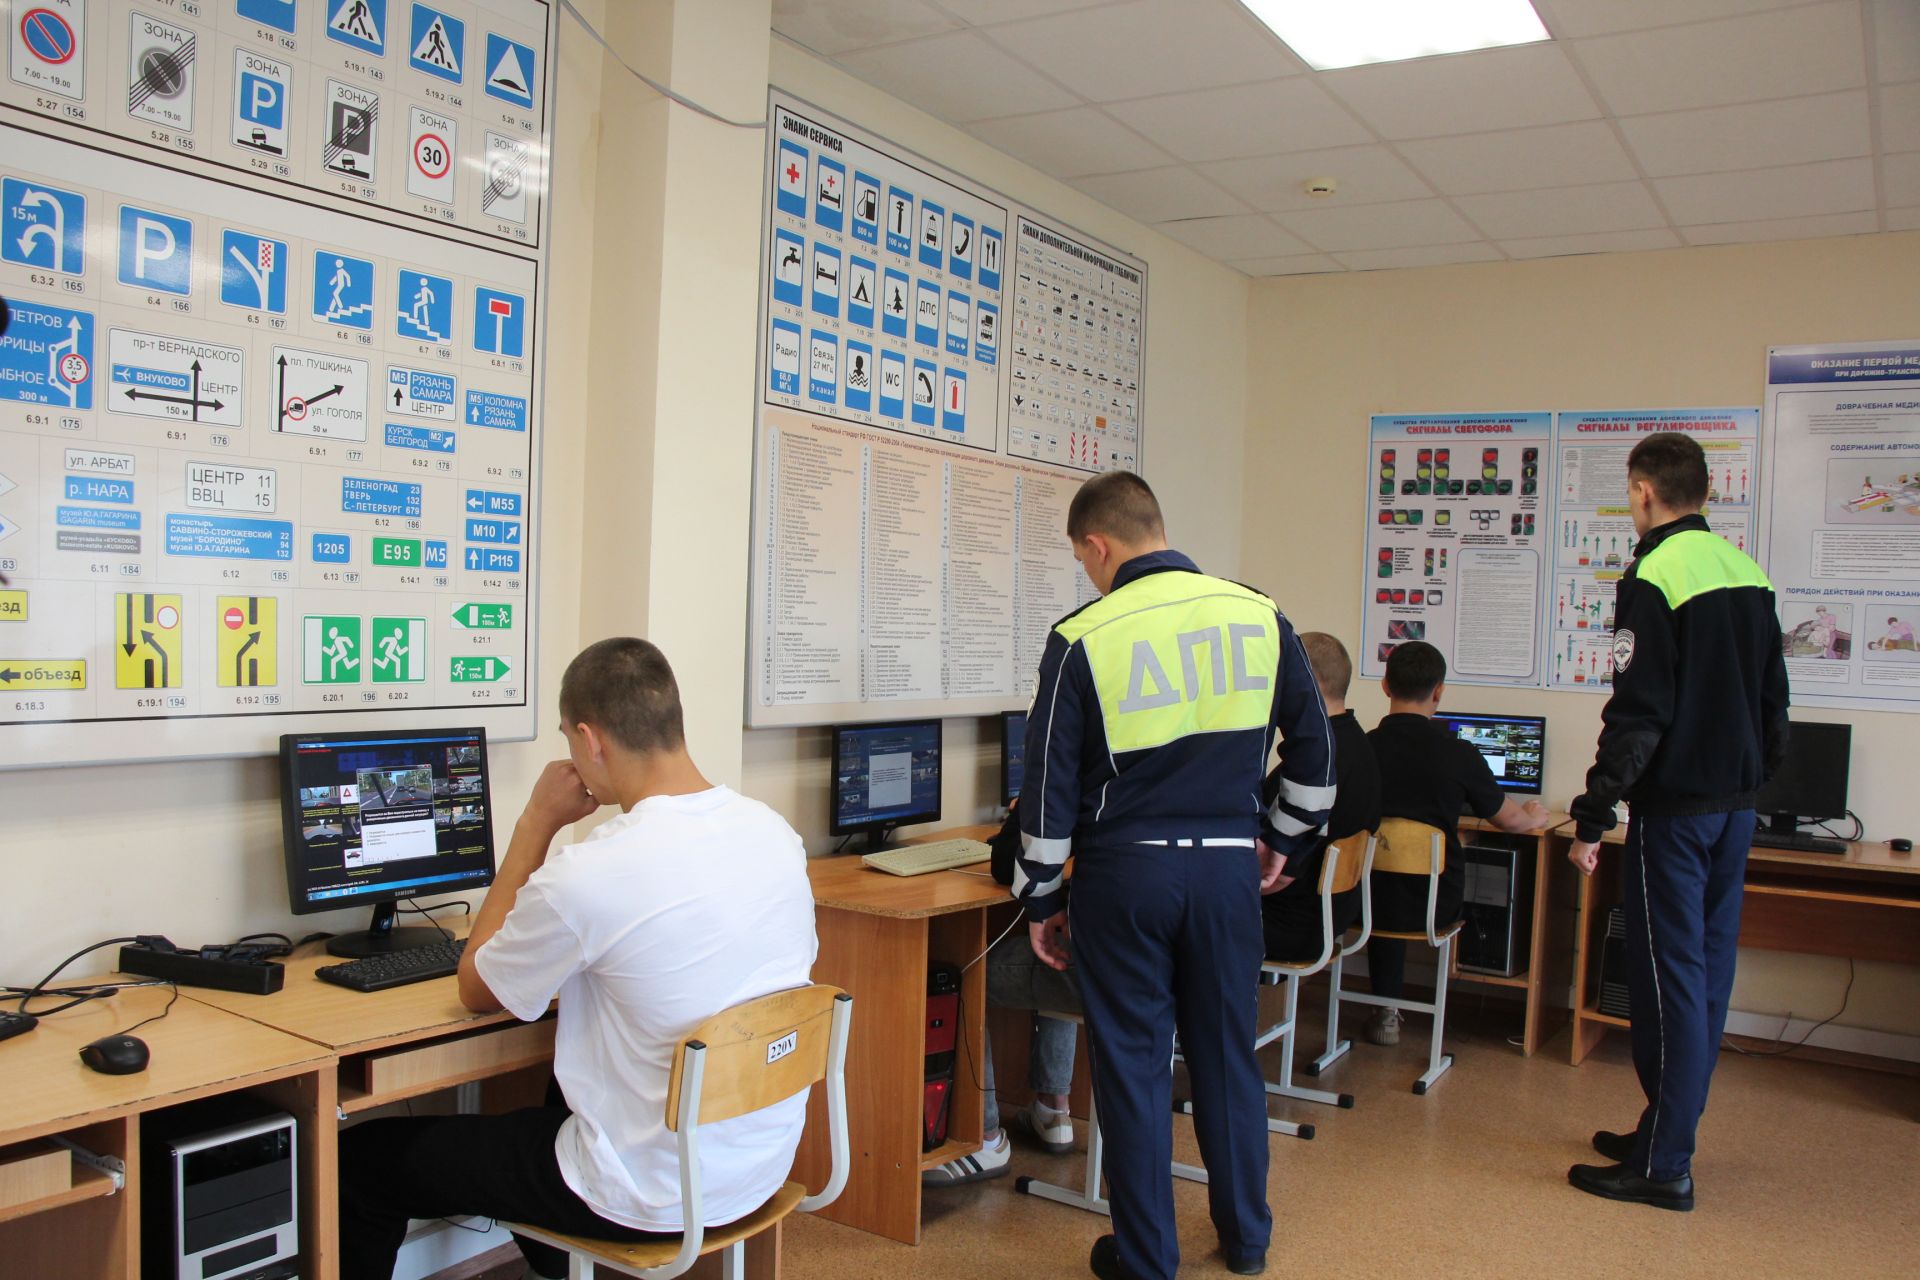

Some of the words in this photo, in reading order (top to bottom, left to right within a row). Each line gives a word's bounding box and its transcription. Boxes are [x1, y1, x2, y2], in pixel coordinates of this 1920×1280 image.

[183, 3, 197, 15] 141
[144, 21, 185, 46] ЗОНА
[257, 30, 274, 42] 5.18
[281, 39, 295, 49] 142
[246, 56, 281, 78] ЗОНА
[344, 61, 365, 73] 5.19.1
[24, 66, 42, 80] 7.00
[50, 74, 71, 88] 19.00
[370, 70, 383, 79] 143
[337, 87, 368, 106] ЗОНА
[449, 96, 462, 107] 144
[36, 97, 58, 111] 5.27
[66, 105, 84, 119] 154
[141, 103, 156, 113] 7.00
[163, 110, 182, 121] 19.00
[419, 114, 448, 131] ЗОНА
[783, 115, 809, 138] ЗНАКИ
[809, 128, 843, 153] СЕРВИСА
[177, 139, 193, 150] 155
[422, 146, 442, 166] 30
[251, 158, 268, 170] 5.29
[274, 164, 289, 175] 156
[341, 183, 356, 193] 5.30
[362, 189, 375, 198] 157
[423, 204, 437, 215] 5.31
[443, 209, 454, 219] 158
[11, 207, 37, 226] 15м
[31, 274, 55, 286] 6.3.2
[65, 281, 83, 291] 165
[148, 296, 161, 306] 6.4
[173, 301, 190, 311] 166
[919, 300, 937, 316] ДПС
[247, 314, 260, 324] 6.5
[271, 319, 285, 328] 167
[358, 335, 371, 344] 168
[133, 339, 154, 353] пр-т
[159, 340, 241, 363] ВЕРНАДСКОГО
[438, 349, 450, 359] 169
[775, 344, 797, 358] Радио
[813, 347, 835, 361] Связь
[290, 358, 304, 367] пл.
[306, 358, 353, 374] ПУШКИНА
[813, 360, 821, 369] 27
[1811, 359, 1860, 369] ОКАЗАНИЕ
[1863, 355, 1901, 366] ПЕРВОЙ
[137, 372, 186, 387] ВНУКОВО
[411, 374, 452, 390] РЯЗАНЬ
[885, 371, 900, 387] WC
[201, 381, 239, 396] ЦЕНТР
[811, 383, 815, 391] 9
[20, 391, 37, 400] 300
[411, 386, 453, 402] САМАРА
[484, 395, 524, 409] КОЛОМНА
[1836, 402, 1893, 411] ДОВРАЧЕБНАЯ
[165, 406, 180, 415] 150
[312, 407, 325, 418] ул.
[327, 407, 363, 421] ГОГОЛЯ
[411, 402, 445, 415] ЦЕНТР
[484, 405, 516, 418] РЯЗАНЬ
[26, 415, 49, 425] 6.9.1
[63, 419, 80, 429] 175
[484, 416, 517, 428] САМАРА
[387, 427, 413, 437] КУРСК
[1406, 426, 1452, 434] СИГНАЛЫ
[1455, 424, 1512, 433] СВЕТОФОРА
[1577, 423, 1630, 432] СИГНАЛЫ
[1637, 421, 1737, 432] РЕГУЛИРОВЩИКА
[167, 431, 187, 440] 6.9.1
[212, 436, 228, 445] 176
[387, 434, 429, 449] БЕЛГОРОД
[309, 447, 326, 456] 6.9.1
[348, 451, 361, 460] 177
[70, 456, 86, 467] ул.
[91, 456, 130, 470] АРБАТ
[439, 461, 450, 470] 178
[192, 468, 245, 484] ЦЕНТР
[258, 474, 271, 488] 11
[70, 483, 82, 495] р.
[88, 483, 129, 499] НАРА
[344, 479, 399, 493] ЗЕЛЕНОГРАД
[410, 486, 420, 494] 23
[192, 488, 224, 506] ВВЦ
[254, 494, 270, 507] 15
[344, 491, 371, 500] ТВЕРЬ
[407, 497, 420, 505] 132
[405, 506, 420, 514] 679
[317, 543, 345, 554] 1205
[91, 564, 109, 572] 6.11
[123, 566, 139, 574] 184
[223, 570, 239, 578] 6.12
[273, 572, 287, 580] 185
[324, 573, 339, 581] 6.13
[346, 574, 359, 582] 187
[400, 576, 420, 584] 6.14.1
[1786, 587, 1821, 595] ПОРЯДОК
[24, 668, 81, 681] объезд
[1119, 623, 1268, 715] ДПС
[169, 697, 185, 706] 194
[236, 696, 259, 705] 6.19.2
[265, 695, 280, 704] 195
[323, 692, 344, 701] 6.20.1
[362, 692, 376, 700] 196
[388, 692, 409, 700] 6.20.2
[15, 701, 45, 711] 6.18.3
[137, 698, 162, 708] 6.19.1
